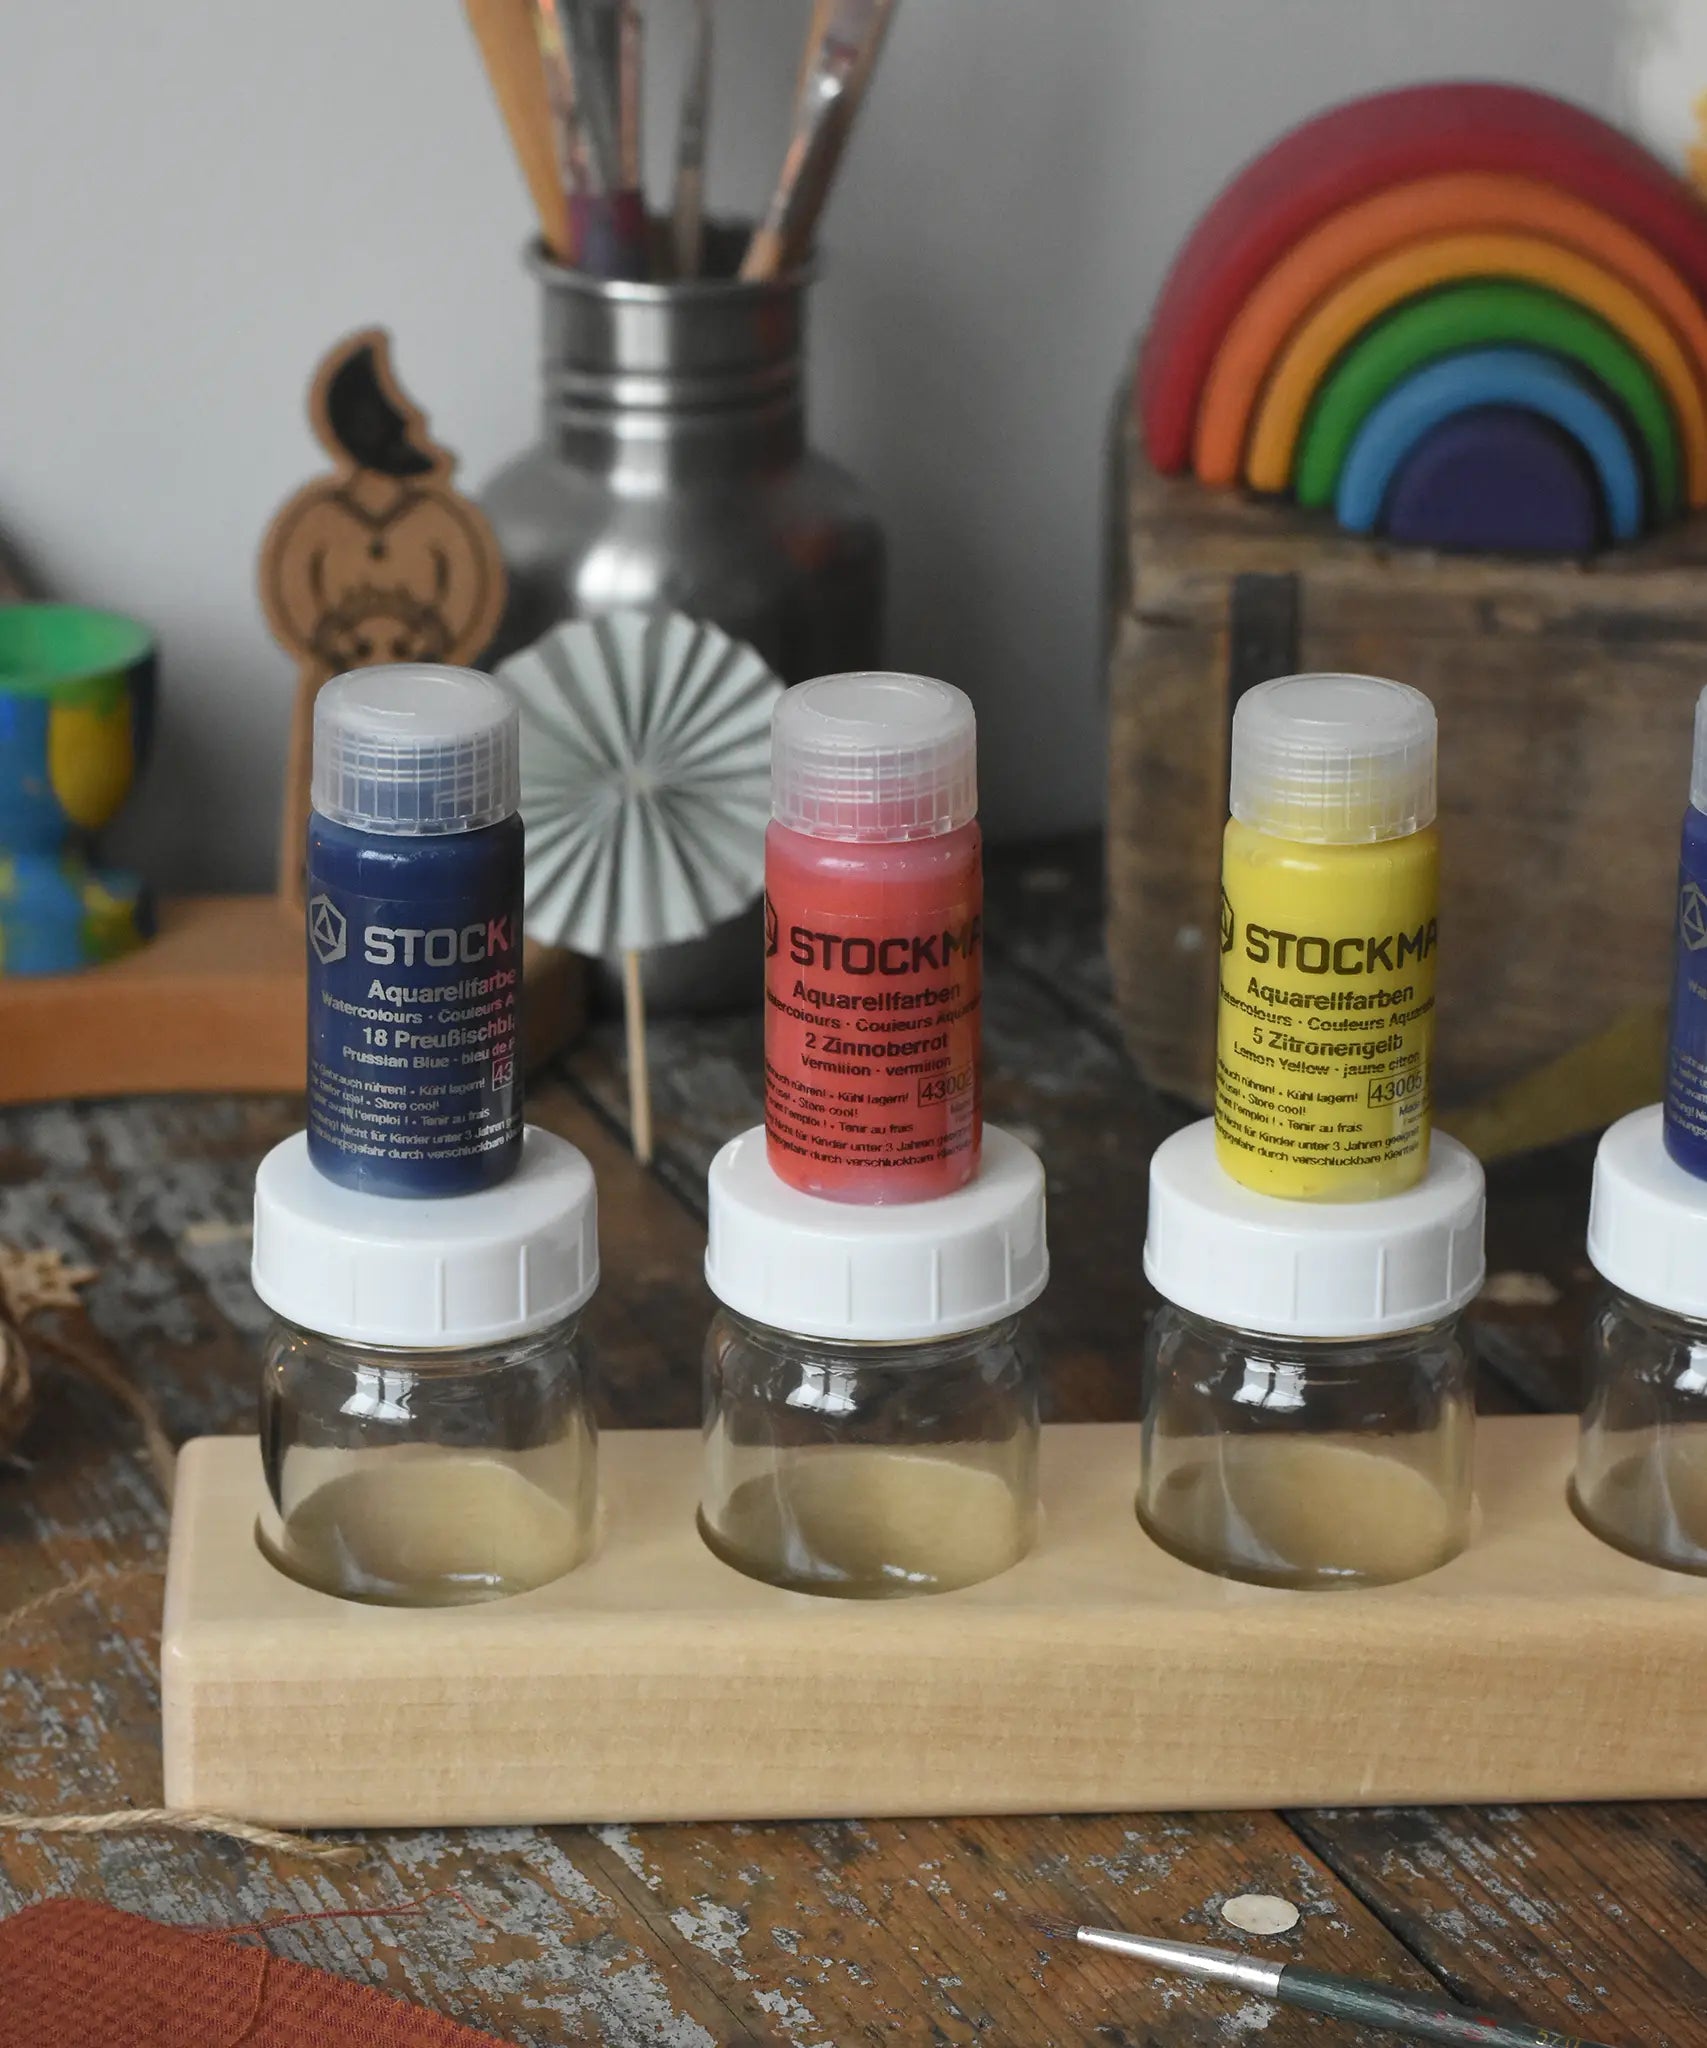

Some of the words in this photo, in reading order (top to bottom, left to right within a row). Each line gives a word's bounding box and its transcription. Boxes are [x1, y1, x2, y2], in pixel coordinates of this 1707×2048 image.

[364, 913, 516, 967] STOCK
[792, 980, 961, 1011] Aquarellfarben
[1247, 976, 1415, 1011] Aquarellfarben
[321, 989, 423, 1024] Watercolours
[363, 1026, 389, 1047] 18
[394, 1013, 516, 1050] Preußischbl
[855, 1017, 933, 1032] Couleurs
[1307, 1016, 1386, 1032] Couleurs
[805, 1031, 817, 1050] 2
[822, 1031, 949, 1057] Zinnoberrot
[1252, 1026, 1264, 1045] 5
[1268, 1031, 1403, 1060] Zitronengelb
[342, 1044, 409, 1069] Prussian
[413, 1056, 450, 1069] Blue
[461, 1048, 490, 1065] bleu
[1233, 1040, 1275, 1068] Lemon
[1279, 1056, 1330, 1076] Yellow
[1343, 1063, 1386, 1079] jaune
[1370, 1070, 1423, 1103] 43005
[374, 1096, 408, 1111] Store
[798, 1096, 826, 1113] Store
[828, 1107, 859, 1118] cool!
[1248, 1093, 1275, 1110] Store
[1278, 1103, 1306, 1116] cool!
[1317, 1092, 1358, 1105] lagern!
[1287, 1118, 1316, 1132] Tenir
[1318, 1124, 1334, 1133] au
[1337, 1122, 1364, 1133] frais
[390, 1132, 430, 1145] Kinder
[811, 1135, 849, 1150] Kinder
[850, 1142, 883, 1153] unter
[885, 1142, 894, 1153] 3
[1243, 1124, 1257, 1138] für
[1258, 1131, 1296, 1148] Kinder
[1297, 1140, 1331, 1151] unter
[1332, 1140, 1341, 1151] 3
[1343, 1139, 1383, 1152] Jahren
[387, 1148, 425, 1160] durch
[809, 1150, 843, 1164] durch
[1257, 1146, 1289, 1162] durch
[1292, 1154, 1381, 1167] verschluckbare
